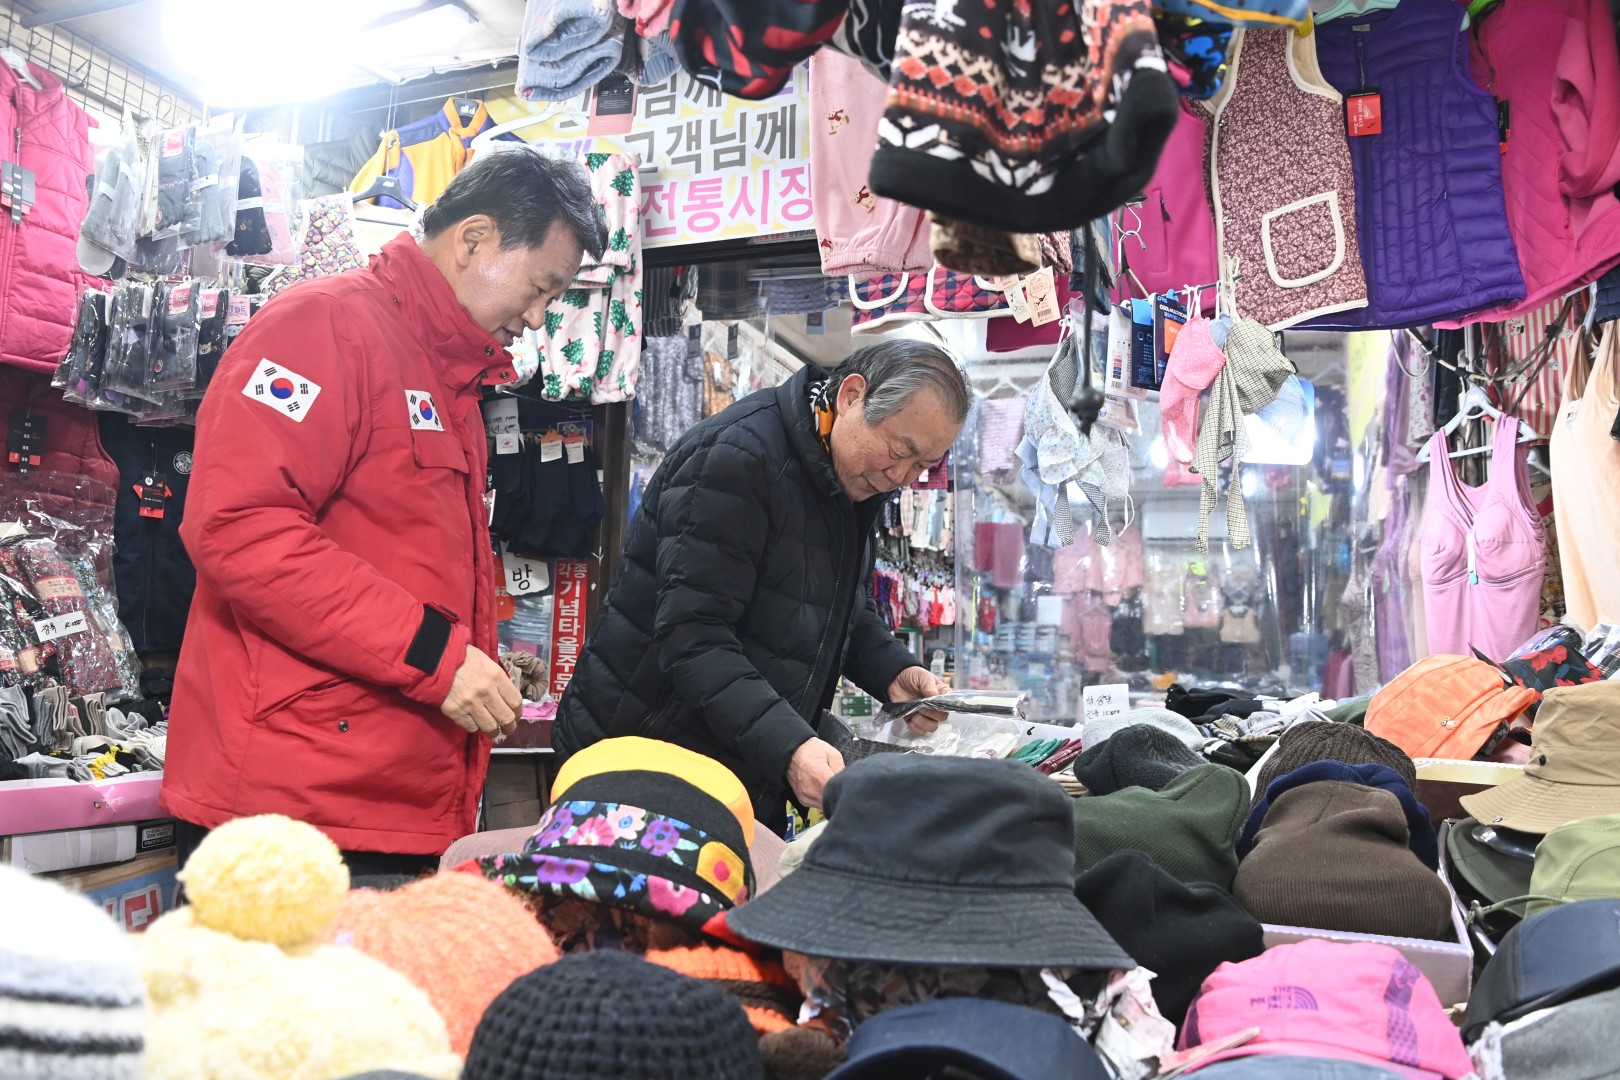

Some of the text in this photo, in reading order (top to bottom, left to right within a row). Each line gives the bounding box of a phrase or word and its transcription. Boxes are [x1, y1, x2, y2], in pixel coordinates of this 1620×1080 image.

[624, 104, 797, 174] 고객님께
[641, 163, 814, 238] 전통시장
[558, 563, 588, 578] 각종
